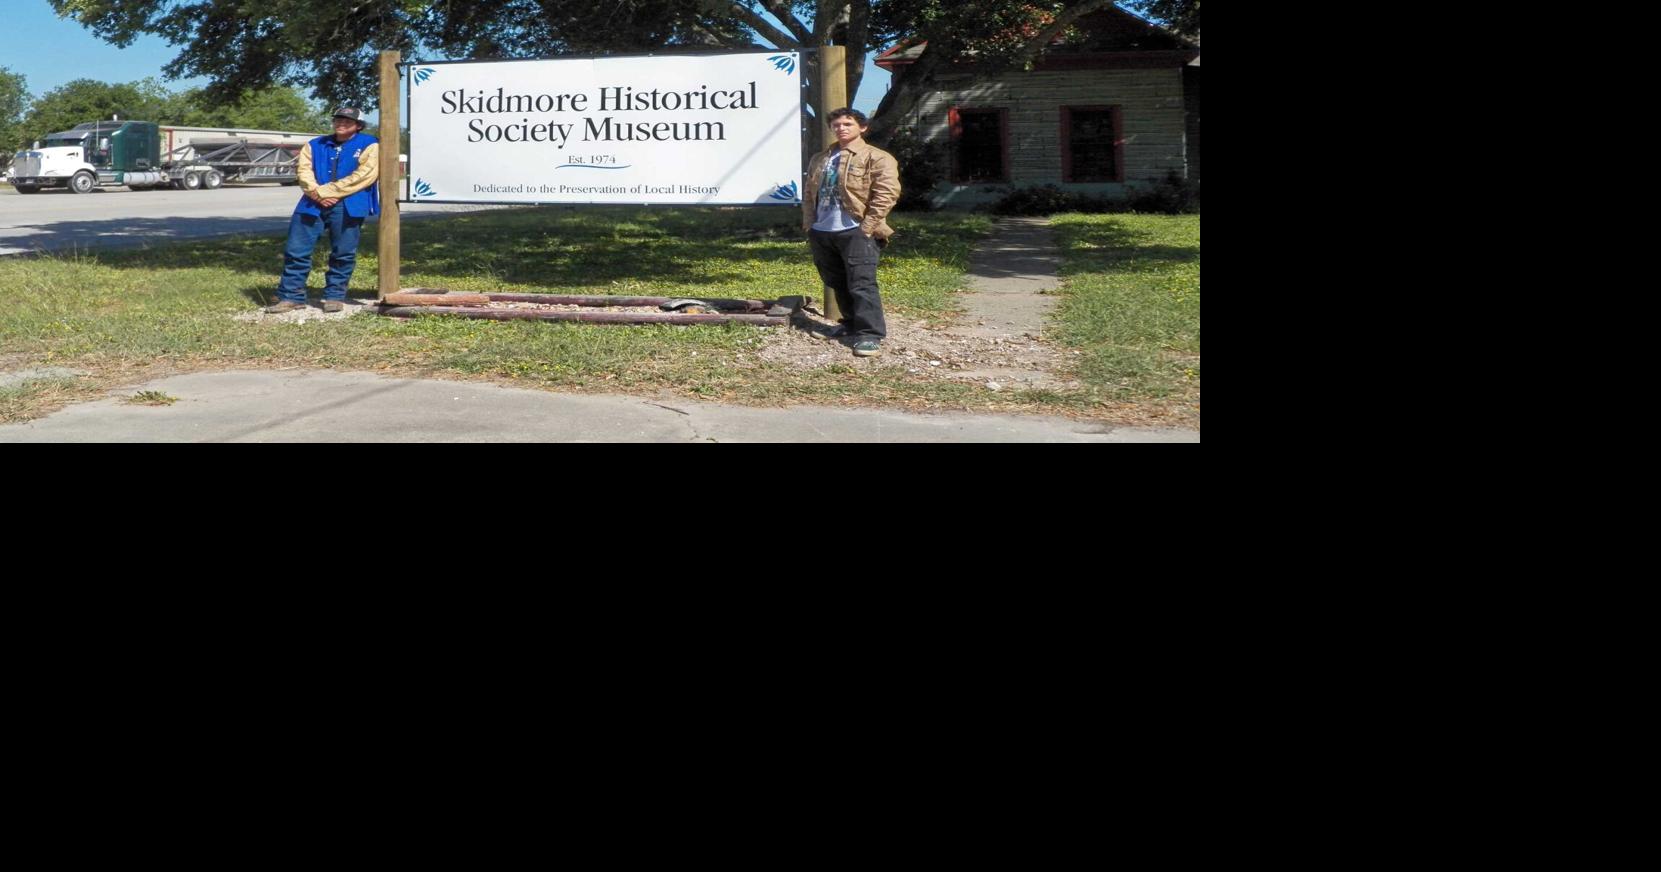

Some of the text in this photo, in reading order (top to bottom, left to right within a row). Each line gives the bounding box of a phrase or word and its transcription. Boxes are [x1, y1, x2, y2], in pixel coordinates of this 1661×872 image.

[441, 81, 759, 115] Skidmore Historical
[468, 117, 726, 149] Society Museum
[568, 154, 616, 165] Est. 1974
[473, 183, 721, 197] Dedicated to the Preservation of Local History
